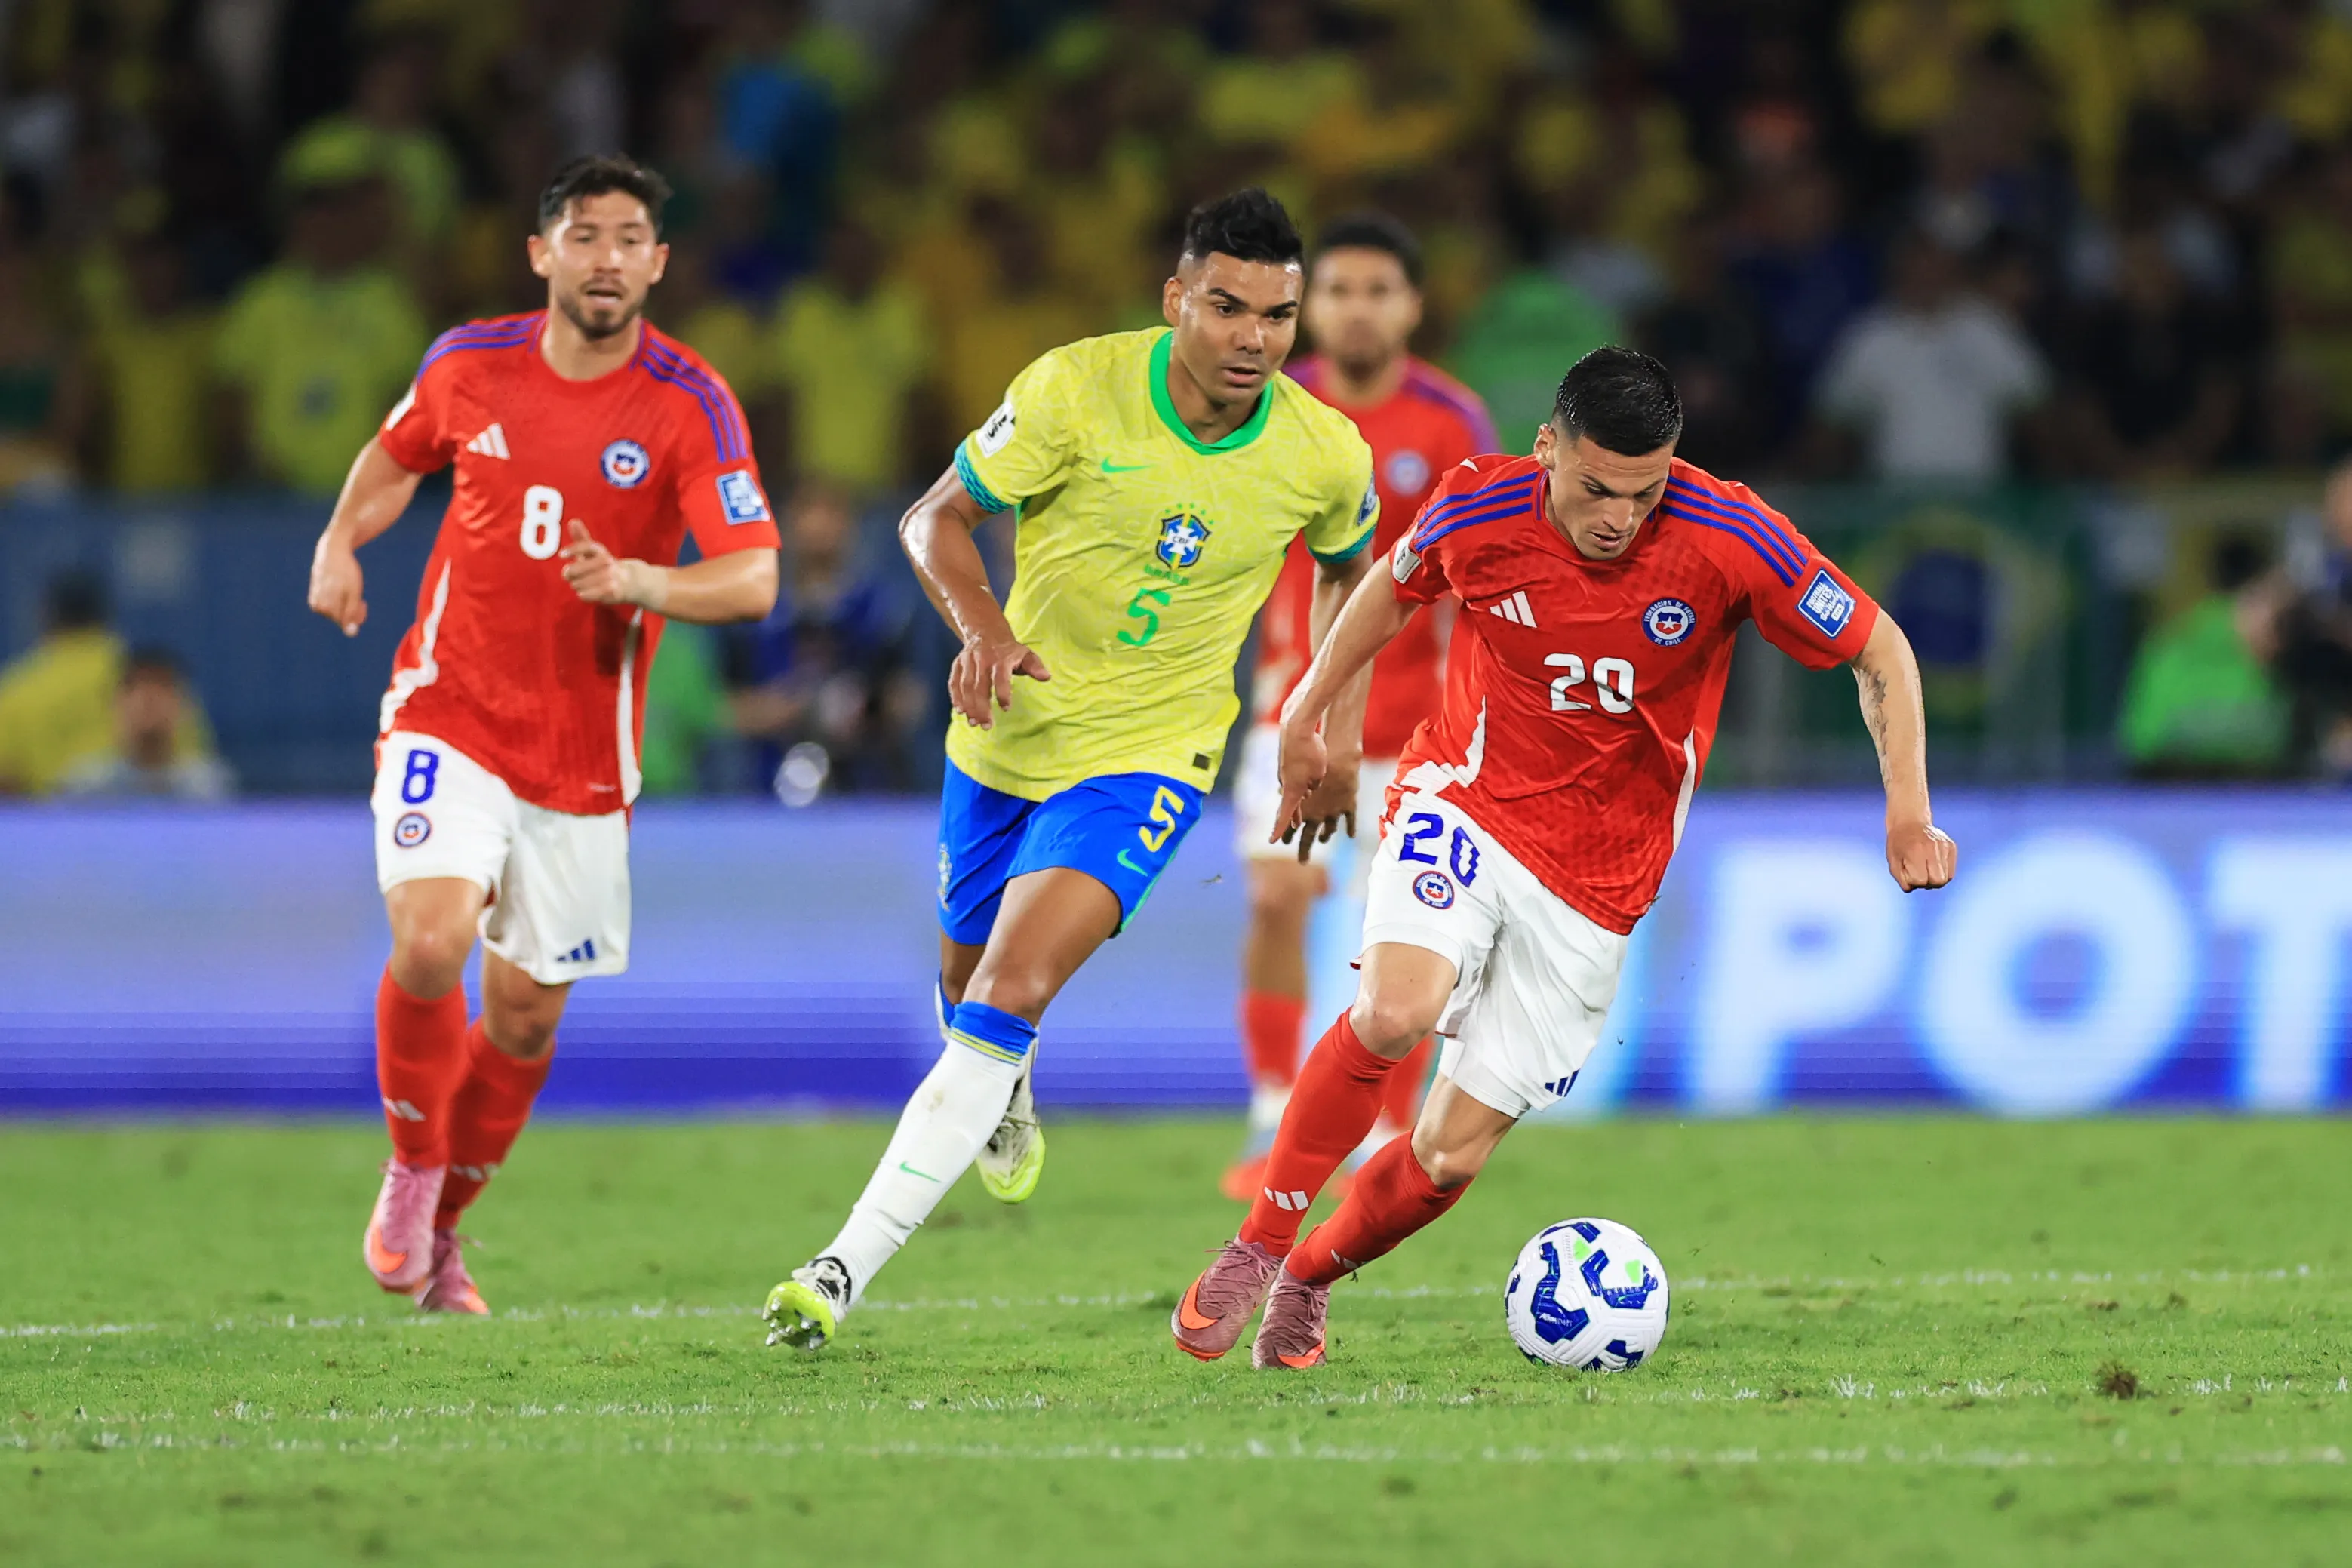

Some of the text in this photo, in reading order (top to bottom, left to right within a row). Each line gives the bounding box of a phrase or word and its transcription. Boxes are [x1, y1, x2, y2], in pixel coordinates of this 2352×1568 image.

[520, 484, 564, 560] 8
[1116, 587, 1171, 647] 5
[1812, 589, 1834, 613] UNITES
[1665, 638, 1681, 646] CHILE
[1544, 653, 1634, 713] 20
[402, 749, 438, 804] 8
[1139, 785, 1185, 853] 5
[1399, 813, 1480, 888] 20
[1690, 832, 2352, 1114] POT
